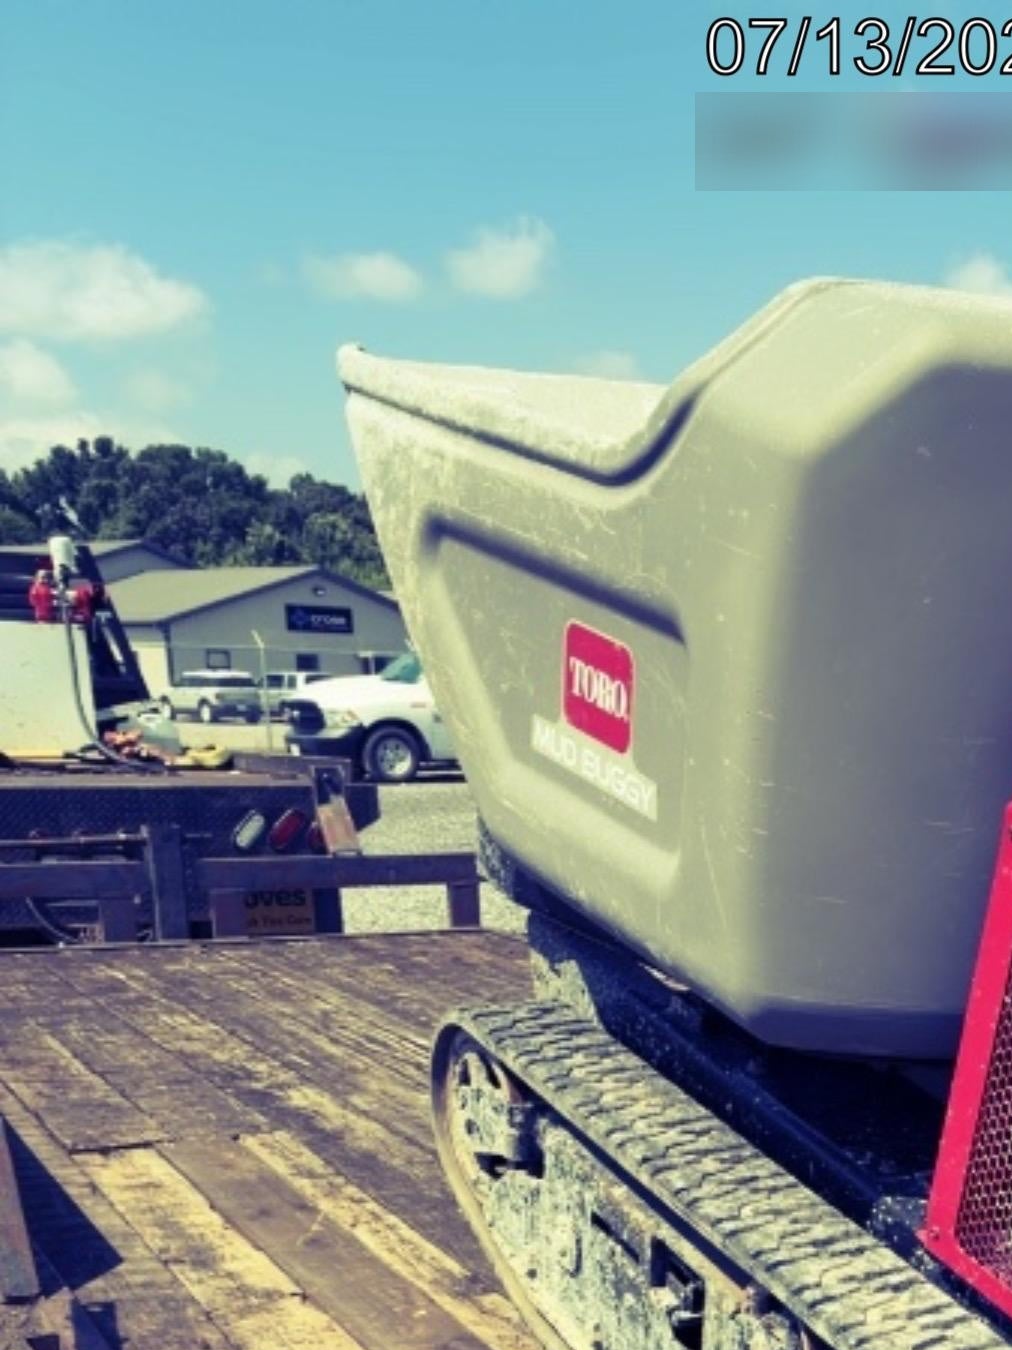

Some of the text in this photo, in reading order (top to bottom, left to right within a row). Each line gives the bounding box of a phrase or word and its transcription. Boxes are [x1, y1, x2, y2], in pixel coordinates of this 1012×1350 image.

[569, 656, 628, 719] TORO
[533, 715, 653, 812] MUD BUGGY
